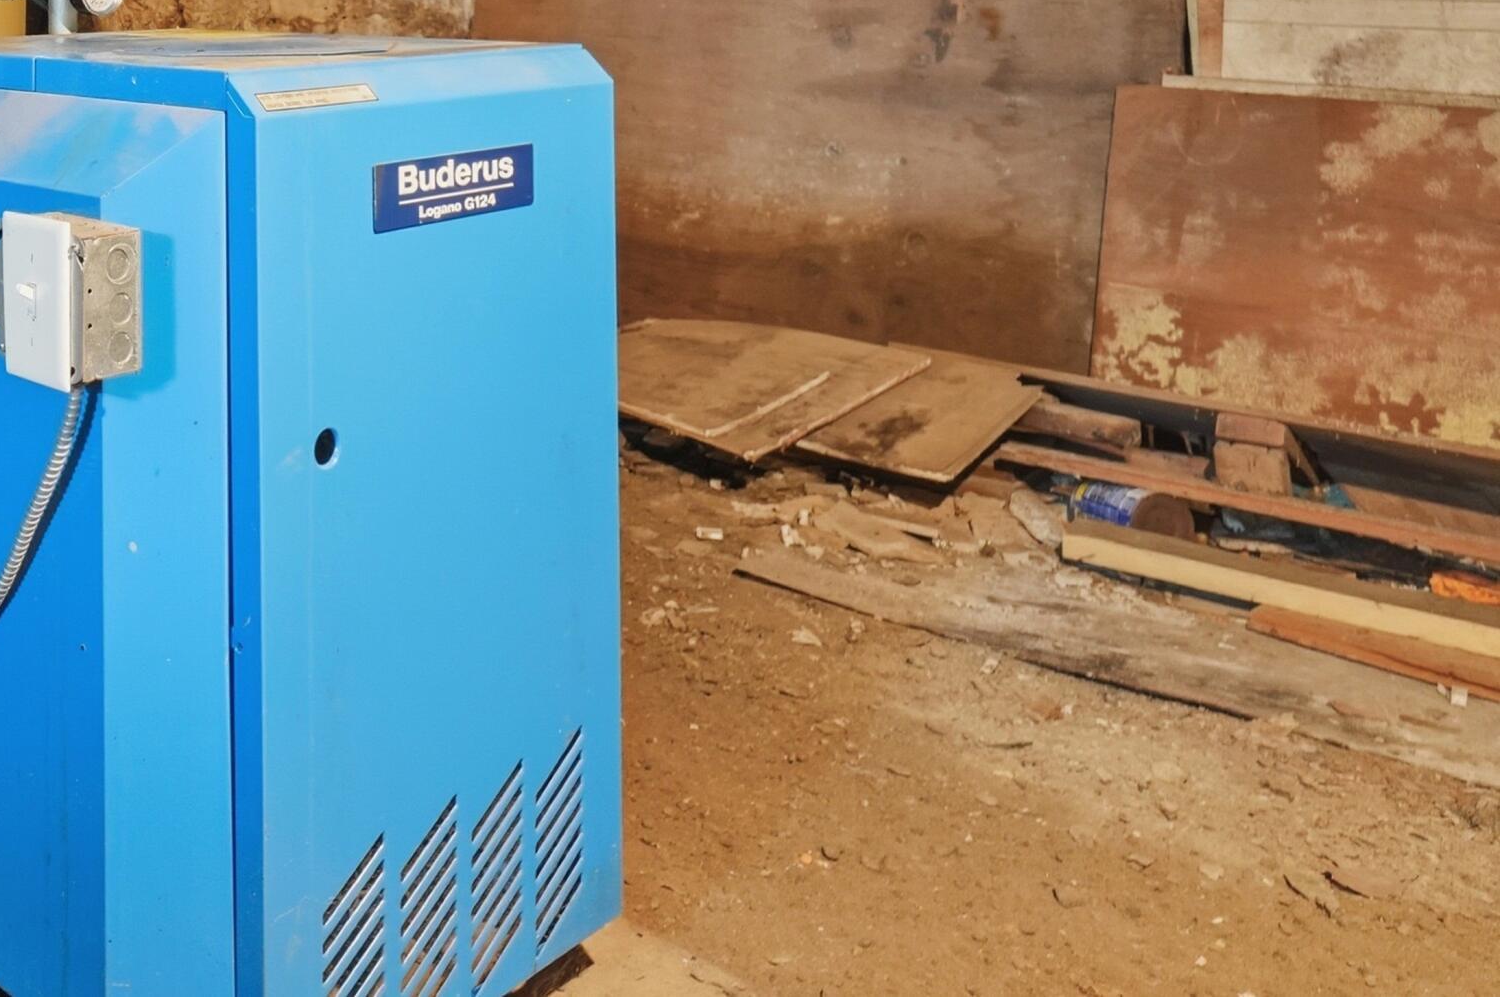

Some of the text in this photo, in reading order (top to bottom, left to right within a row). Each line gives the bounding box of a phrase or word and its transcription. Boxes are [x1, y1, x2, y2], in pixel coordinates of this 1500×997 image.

[398, 156, 514, 196] Buderus
[418, 193, 496, 219] Logano G124
